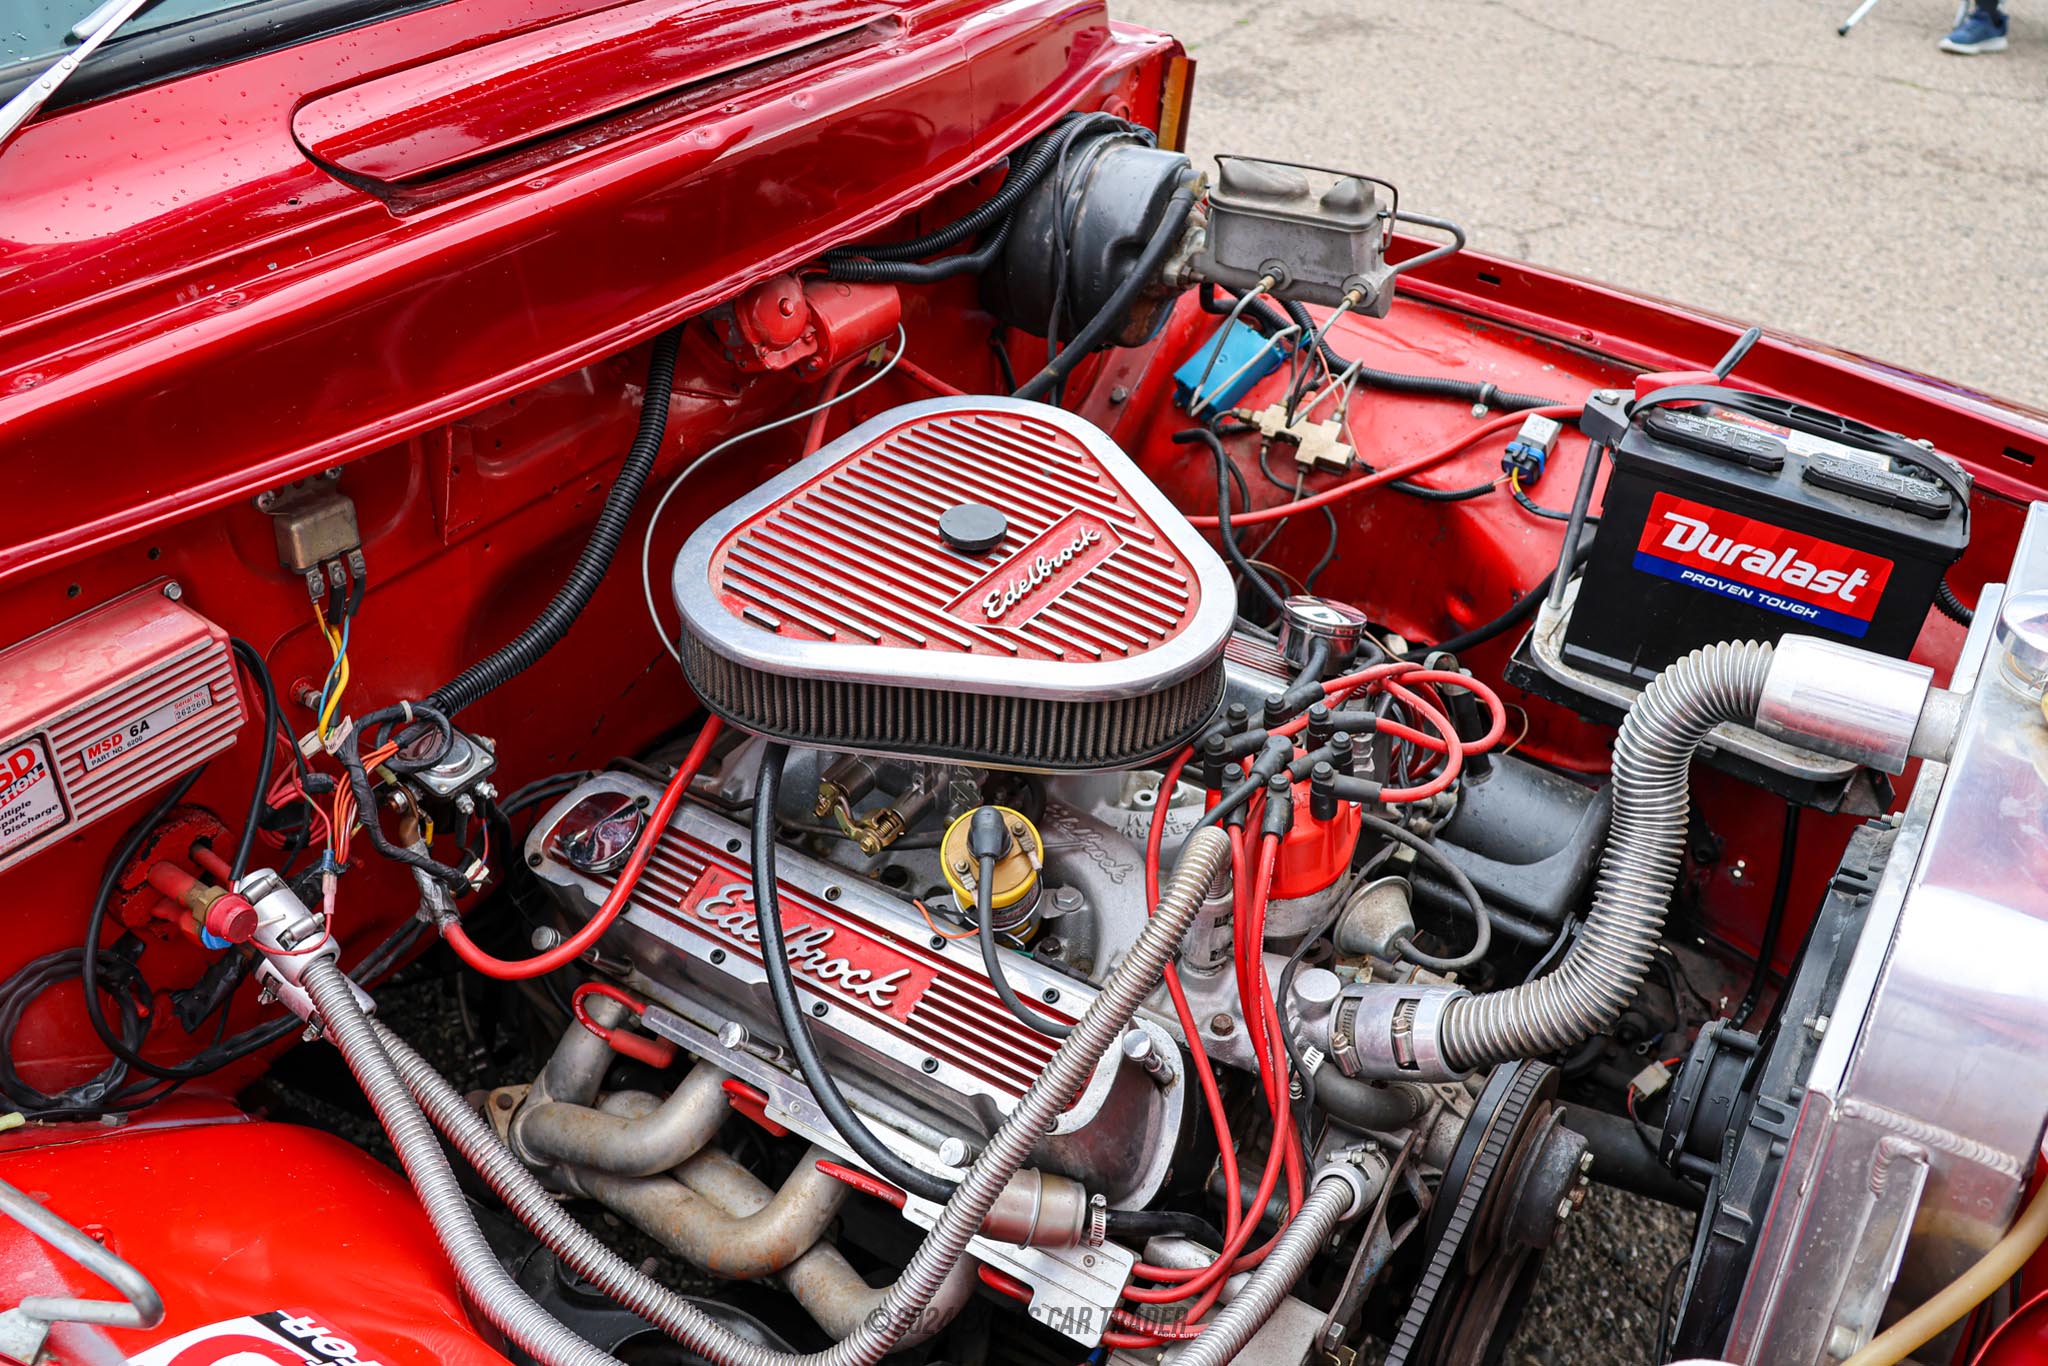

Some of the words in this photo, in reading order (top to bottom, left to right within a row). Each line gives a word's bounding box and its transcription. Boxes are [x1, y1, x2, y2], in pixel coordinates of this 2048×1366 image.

[982, 526, 1102, 620] Edelbrock
[1662, 511, 1868, 603] Duralast
[1680, 570, 1754, 598] PROVEN
[1758, 593, 1818, 618] TOUGH
[87, 733, 123, 760] MSD
[129, 720, 150, 738] 6A
[91, 752, 111, 767] PART
[127, 735, 143, 748] 6200
[0, 748, 36, 793] SD
[0, 800, 32, 821] ultiple
[0, 812, 26, 831] park
[3, 804, 59, 837] Discharge
